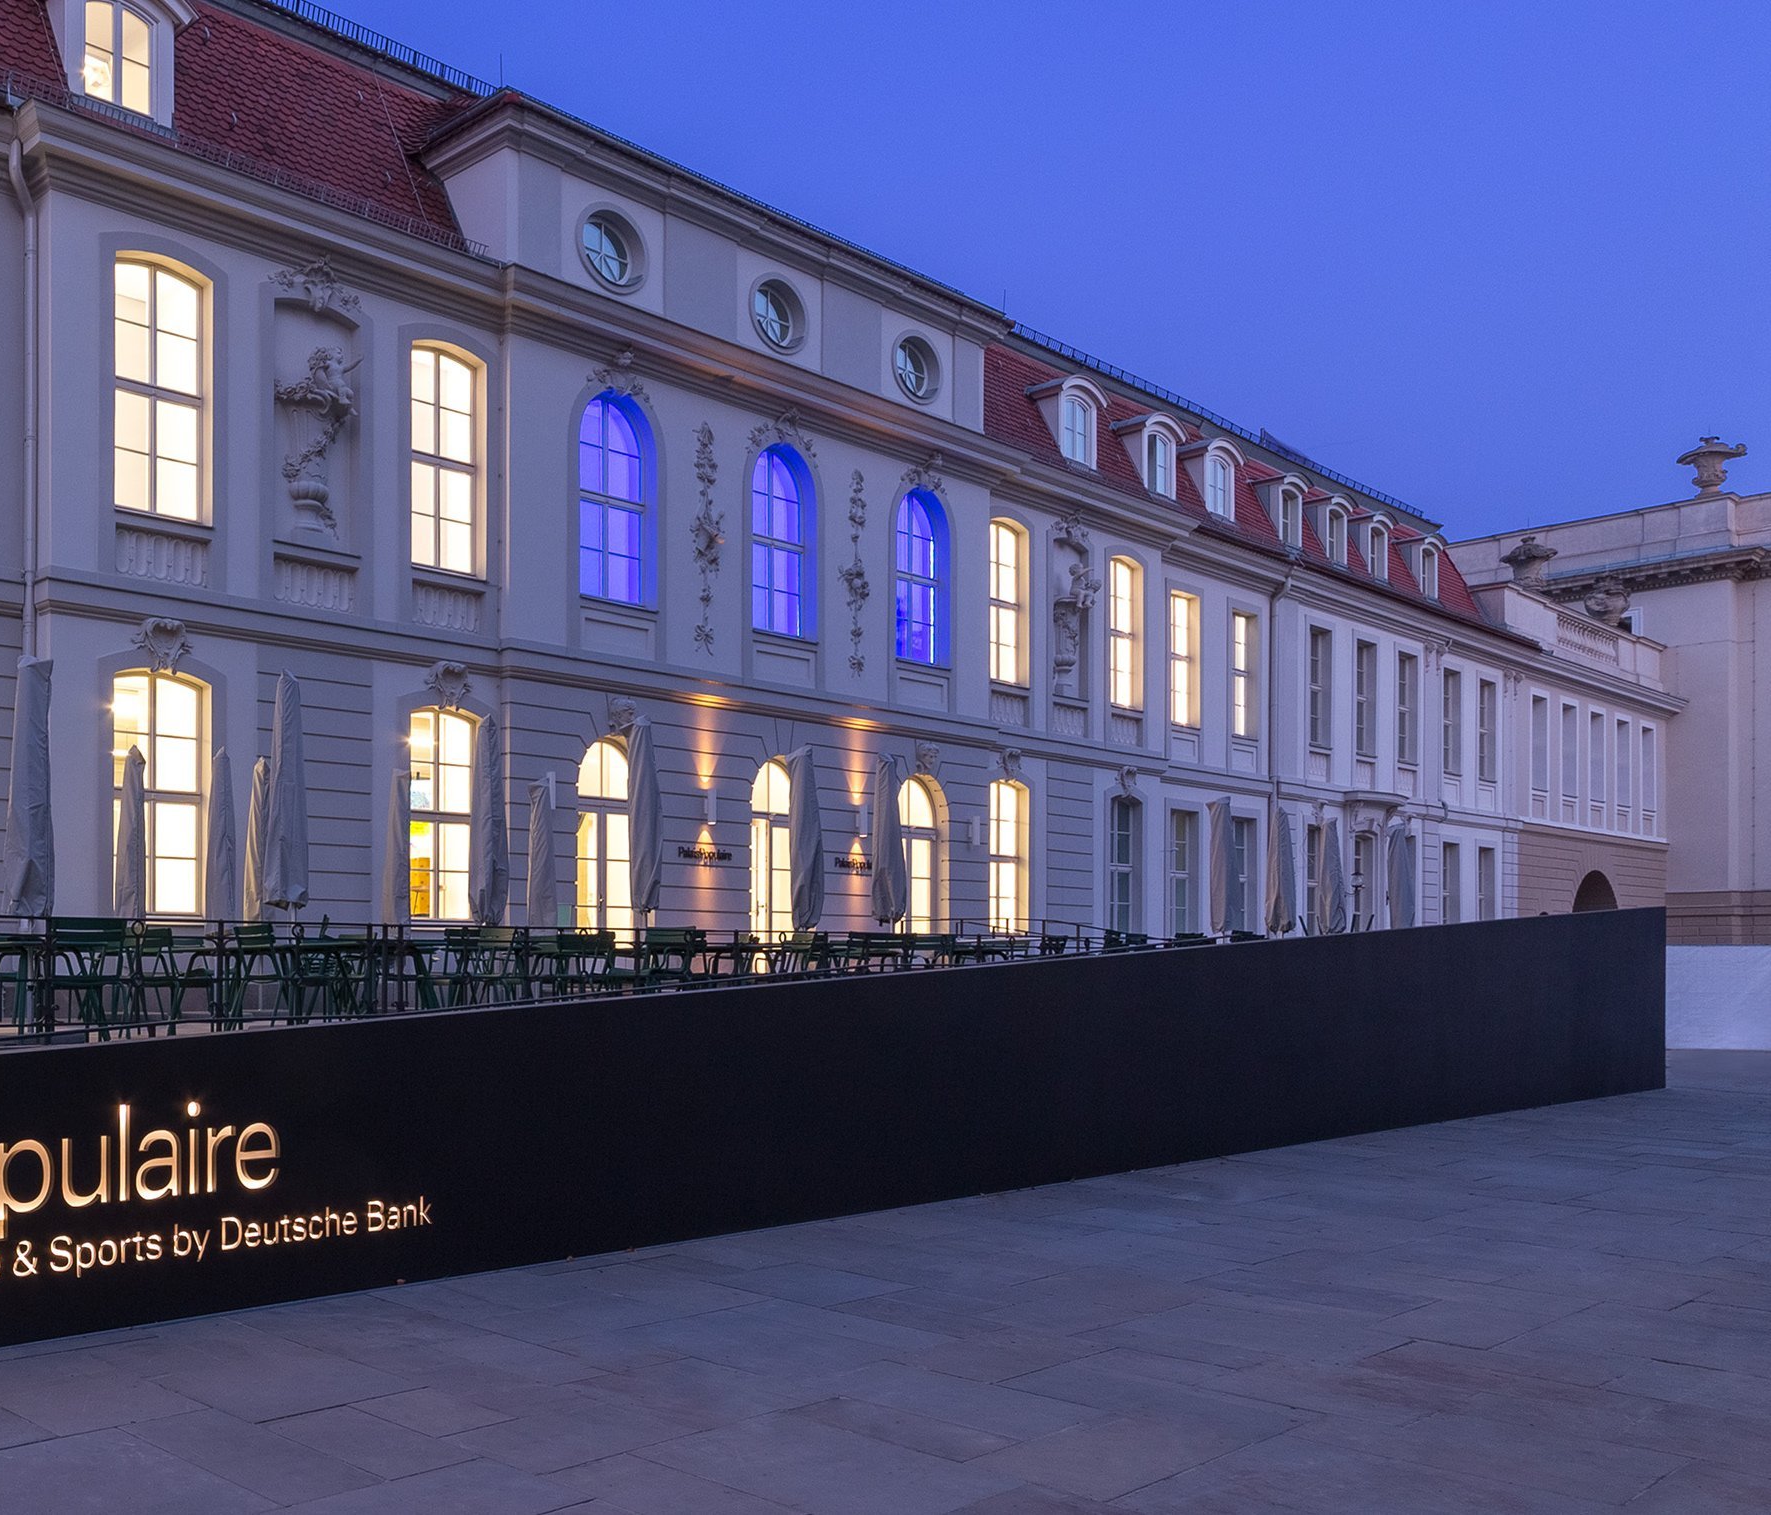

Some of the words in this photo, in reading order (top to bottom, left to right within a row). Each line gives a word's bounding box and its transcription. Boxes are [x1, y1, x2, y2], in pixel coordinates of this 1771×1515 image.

[12, 1239, 40, 1278] &
[49, 1231, 164, 1279] Sports
[172, 1223, 212, 1263] by
[220, 1206, 359, 1251] Deutsche
[366, 1194, 434, 1233] Bank
